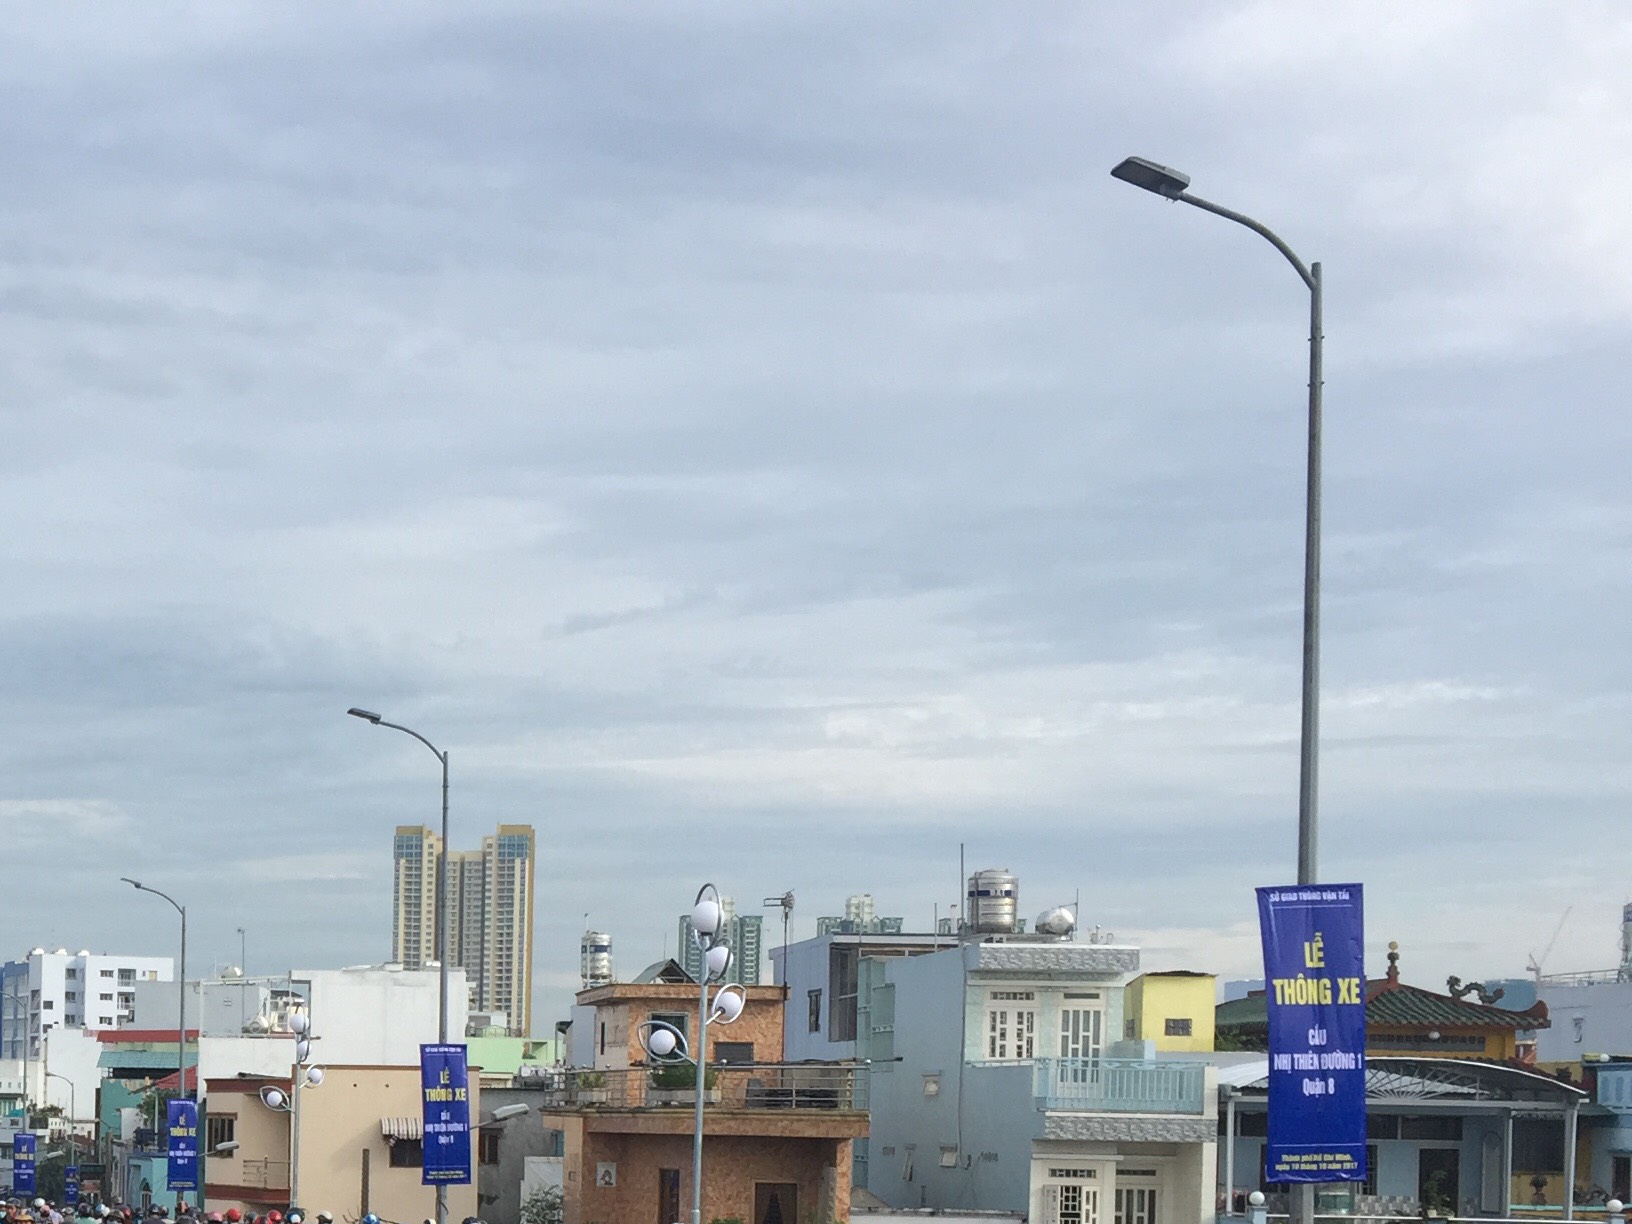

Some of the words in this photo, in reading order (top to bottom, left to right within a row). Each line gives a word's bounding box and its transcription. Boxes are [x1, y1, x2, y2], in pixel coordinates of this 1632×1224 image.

[1303, 931, 1325, 968] LỄ
[1272, 972, 1332, 1005] THÔNG
[1336, 977, 1361, 1005] XE
[1273, 1053, 1292, 1074] NHỊ
[1293, 1050, 1320, 1070] THIÊN
[1320, 1048, 1356, 1070] ĐƯỜNG
[1357, 1052, 1362, 1070] 1
[1302, 1077, 1326, 1098] Quận
[1328, 1077, 1335, 1095] 8
